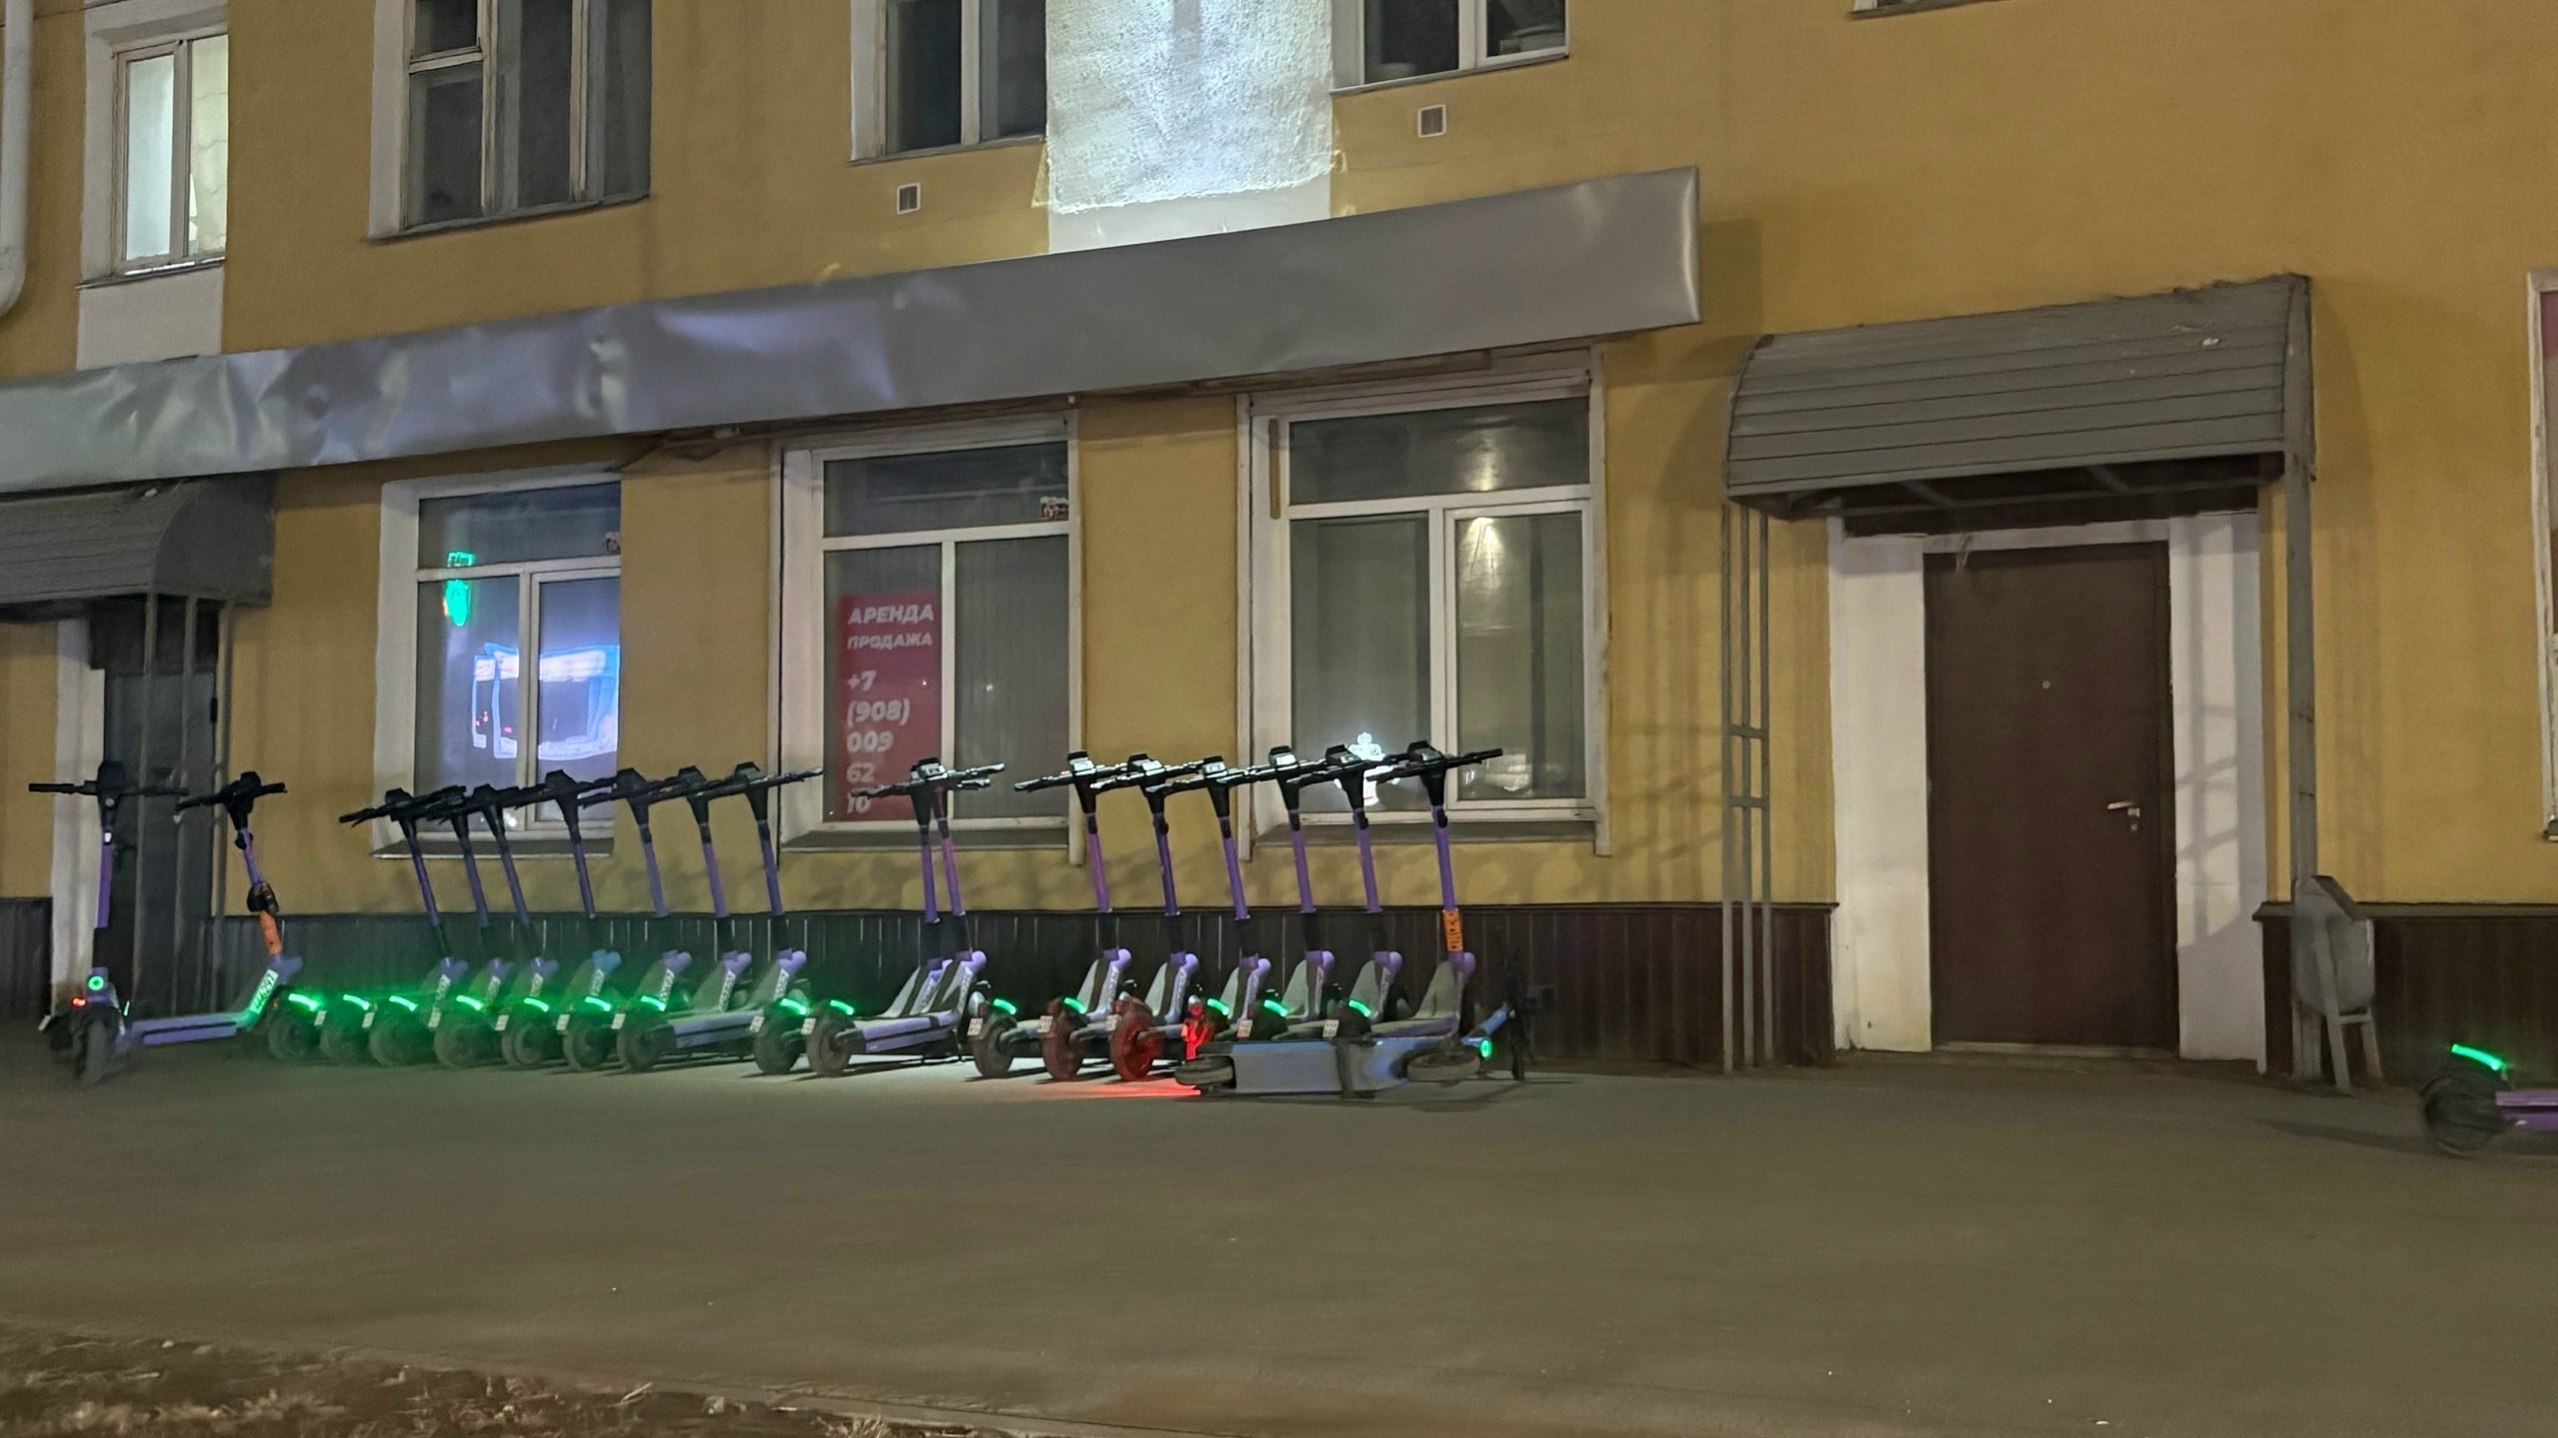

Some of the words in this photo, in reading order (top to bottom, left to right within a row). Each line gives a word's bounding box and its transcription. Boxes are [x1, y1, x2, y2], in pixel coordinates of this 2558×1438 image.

[847, 603, 934, 625] АРЕНДА
[847, 632, 933, 650] ПРОДАЖА
[847, 670, 876, 691] +7
[847, 699, 910, 727] (908)
[847, 730, 894, 753] 009
[847, 762, 875, 784] 62
